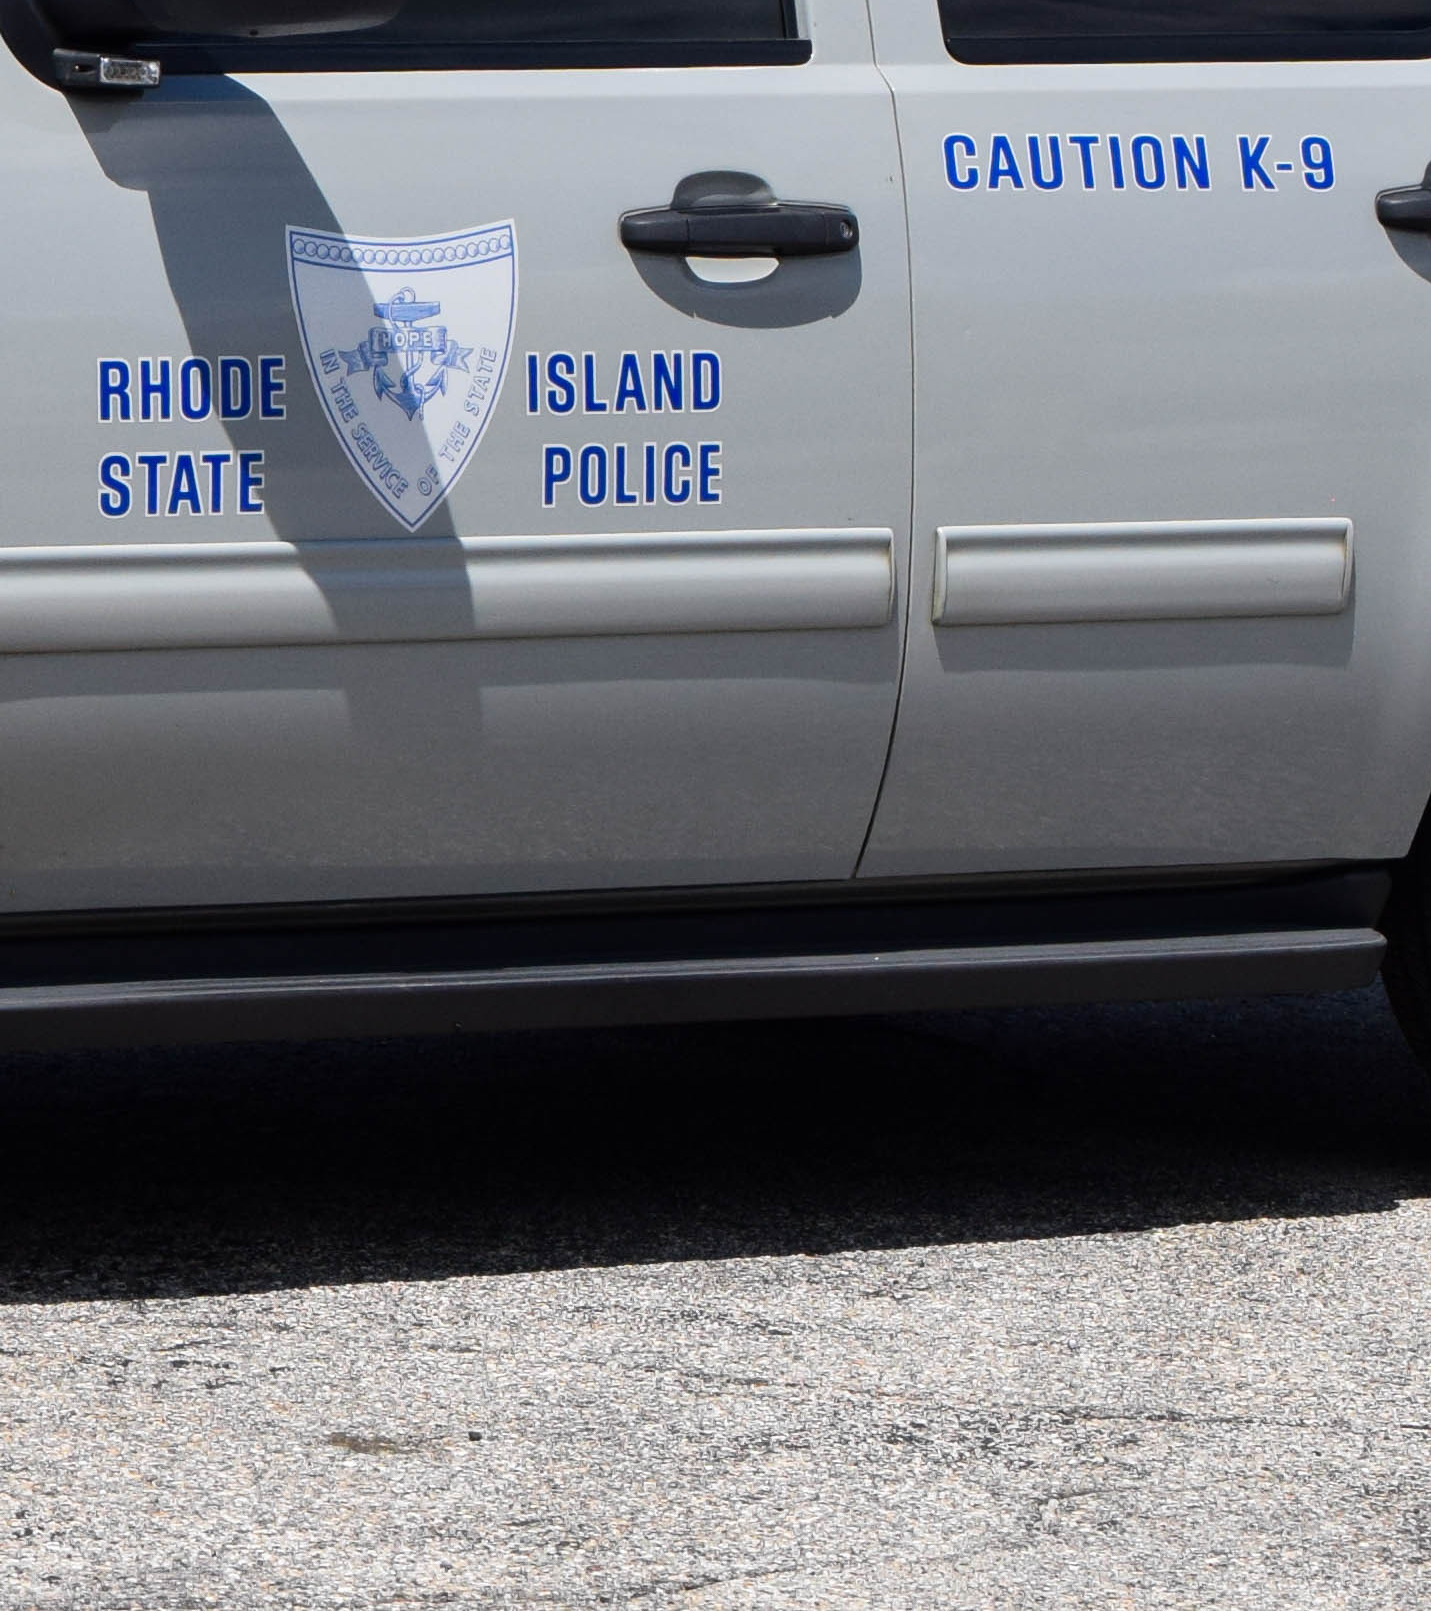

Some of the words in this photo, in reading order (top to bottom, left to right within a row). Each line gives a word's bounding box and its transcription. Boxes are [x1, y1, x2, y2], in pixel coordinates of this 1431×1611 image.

[941, 132, 1212, 192] CAUTION
[1235, 134, 1336, 192] K-9
[382, 331, 434, 349] HOPE
[97, 355, 286, 423] RHODE
[525, 349, 722, 416] ISLAND
[320, 349, 340, 374] IN
[330, 380, 359, 423] THE
[352, 423, 409, 499] SERVICE
[417, 466, 439, 497] OF
[439, 421, 471, 463] THE
[464, 347, 497, 417] STATE
[98, 449, 264, 518] STATE
[542, 440, 723, 508] POLICE
